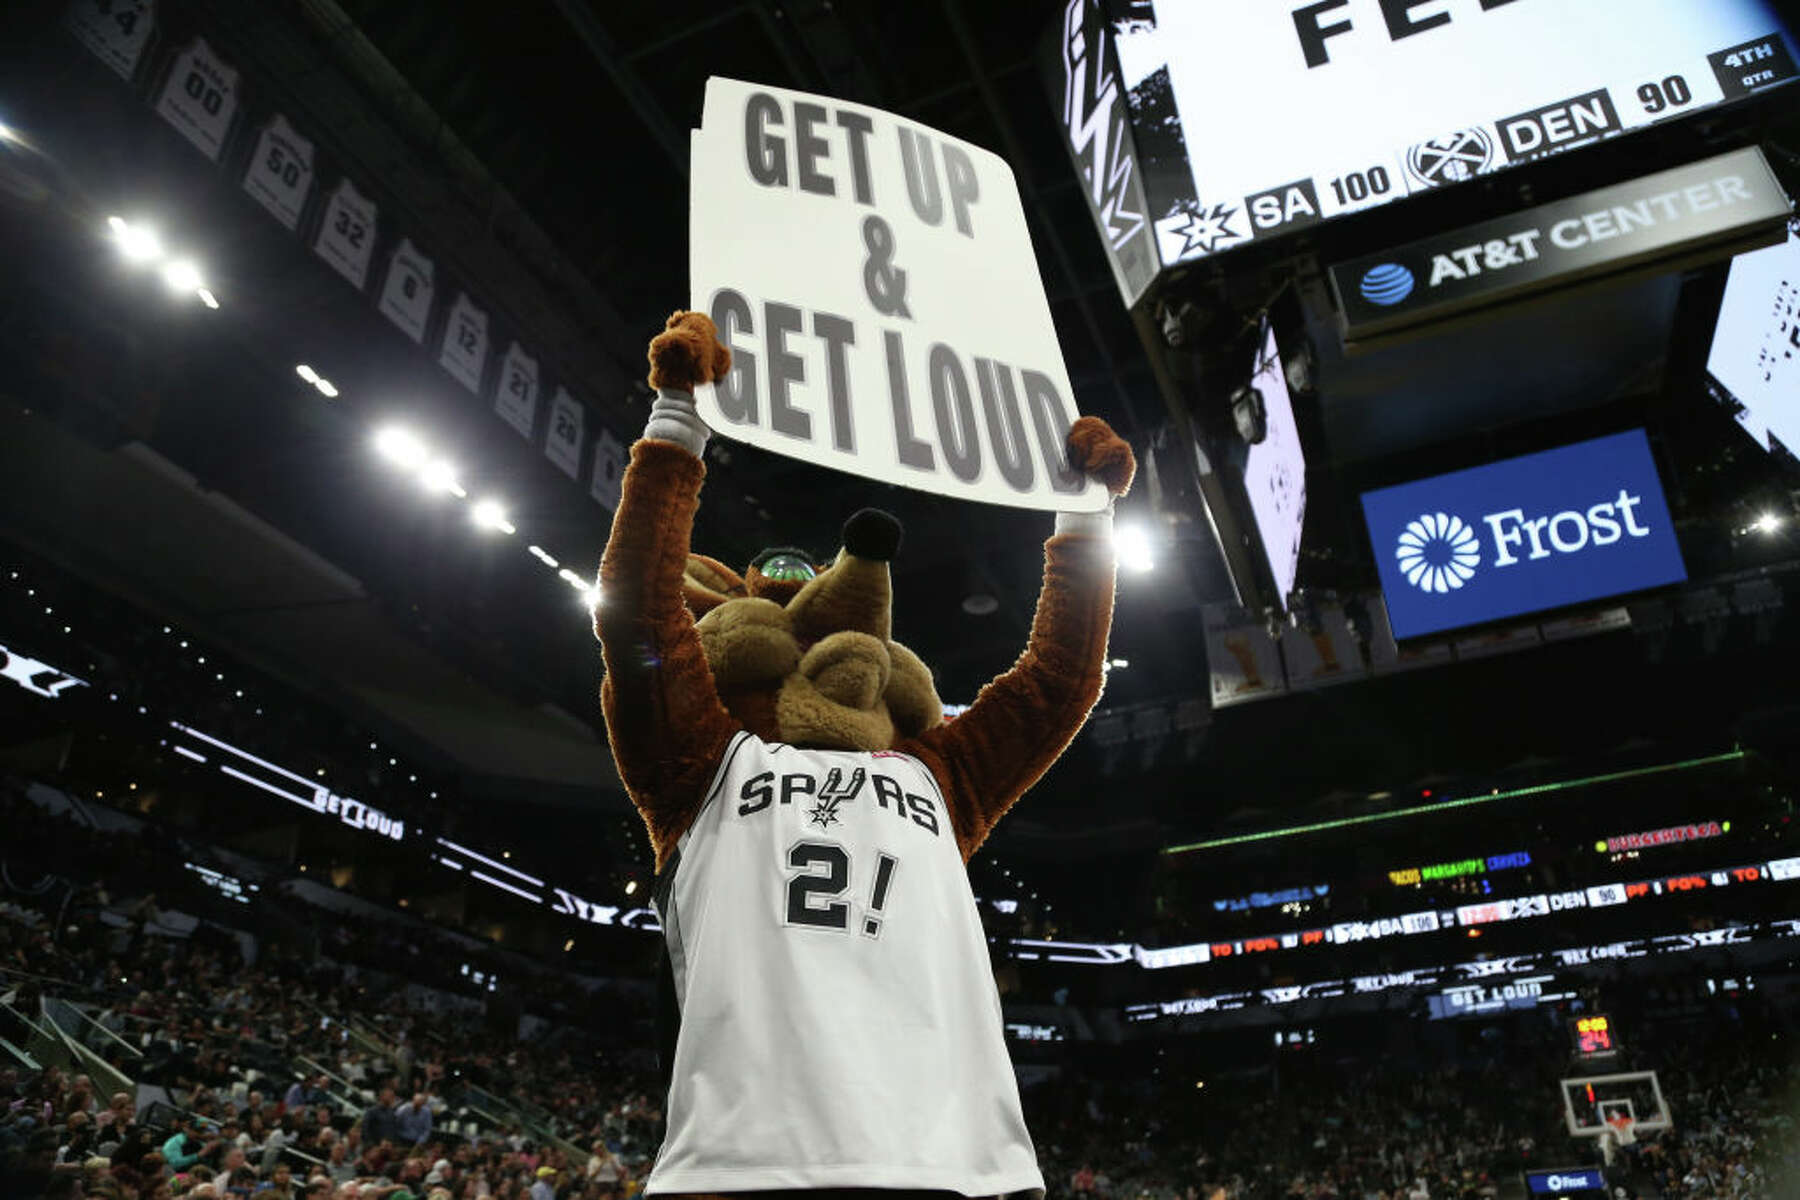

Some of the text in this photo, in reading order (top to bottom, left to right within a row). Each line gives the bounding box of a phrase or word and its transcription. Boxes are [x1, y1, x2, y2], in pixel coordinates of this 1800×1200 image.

[1292, 0, 1522, 69] FE
[1723, 43, 1774, 68] 4TH
[185, 71, 224, 117] 00
[1742, 69, 1774, 88] QTR
[266, 146, 300, 188] 50
[744, 92, 980, 239] GET UP
[1252, 186, 1316, 229] SA
[1331, 165, 1391, 206] 100
[1505, 97, 1610, 154] DEN
[1636, 74, 1692, 114] 90
[334, 209, 366, 249] 32
[1429, 174, 1754, 287] AT&T CENTER
[861, 214, 913, 321] &
[458, 323, 477, 356] 12
[510, 371, 530, 402] 21
[710, 287, 1087, 495] GET LOUD
[1482, 489, 1650, 567] Frost
[737, 767, 941, 837] SPURS
[1550, 891, 1587, 911] DEN
[1732, 867, 1760, 882] TO
[1579, 1030, 1611, 1052] 24
